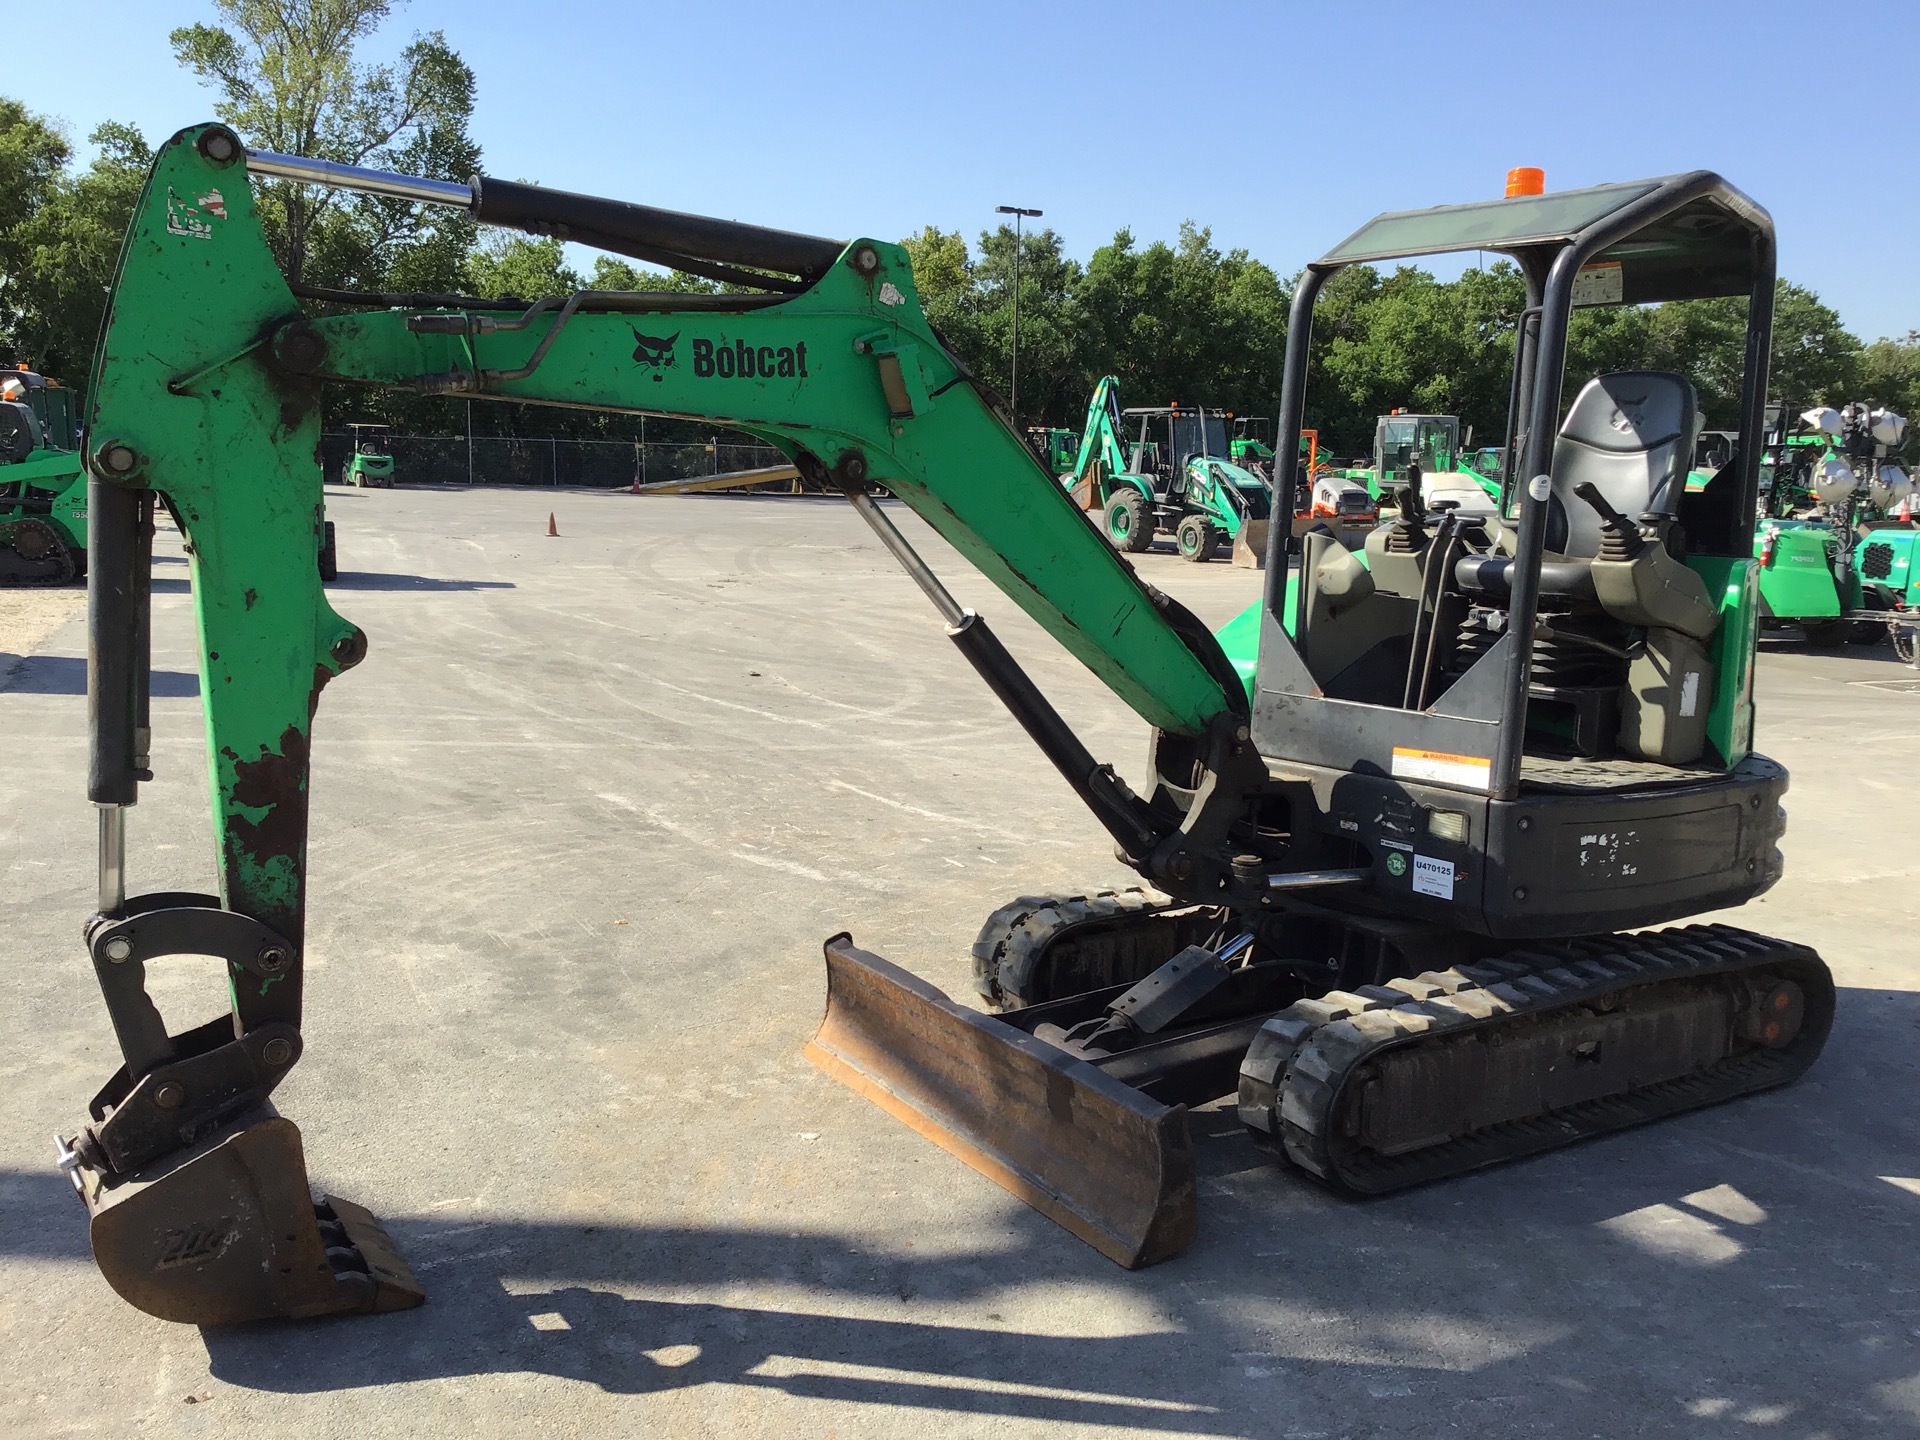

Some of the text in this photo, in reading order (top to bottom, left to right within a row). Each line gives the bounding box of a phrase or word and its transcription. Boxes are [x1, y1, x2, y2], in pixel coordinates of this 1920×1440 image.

[692, 338, 808, 378] Bobcat
[1429, 752, 1459, 762] WARNING
[1416, 861, 1451, 876] U470125
